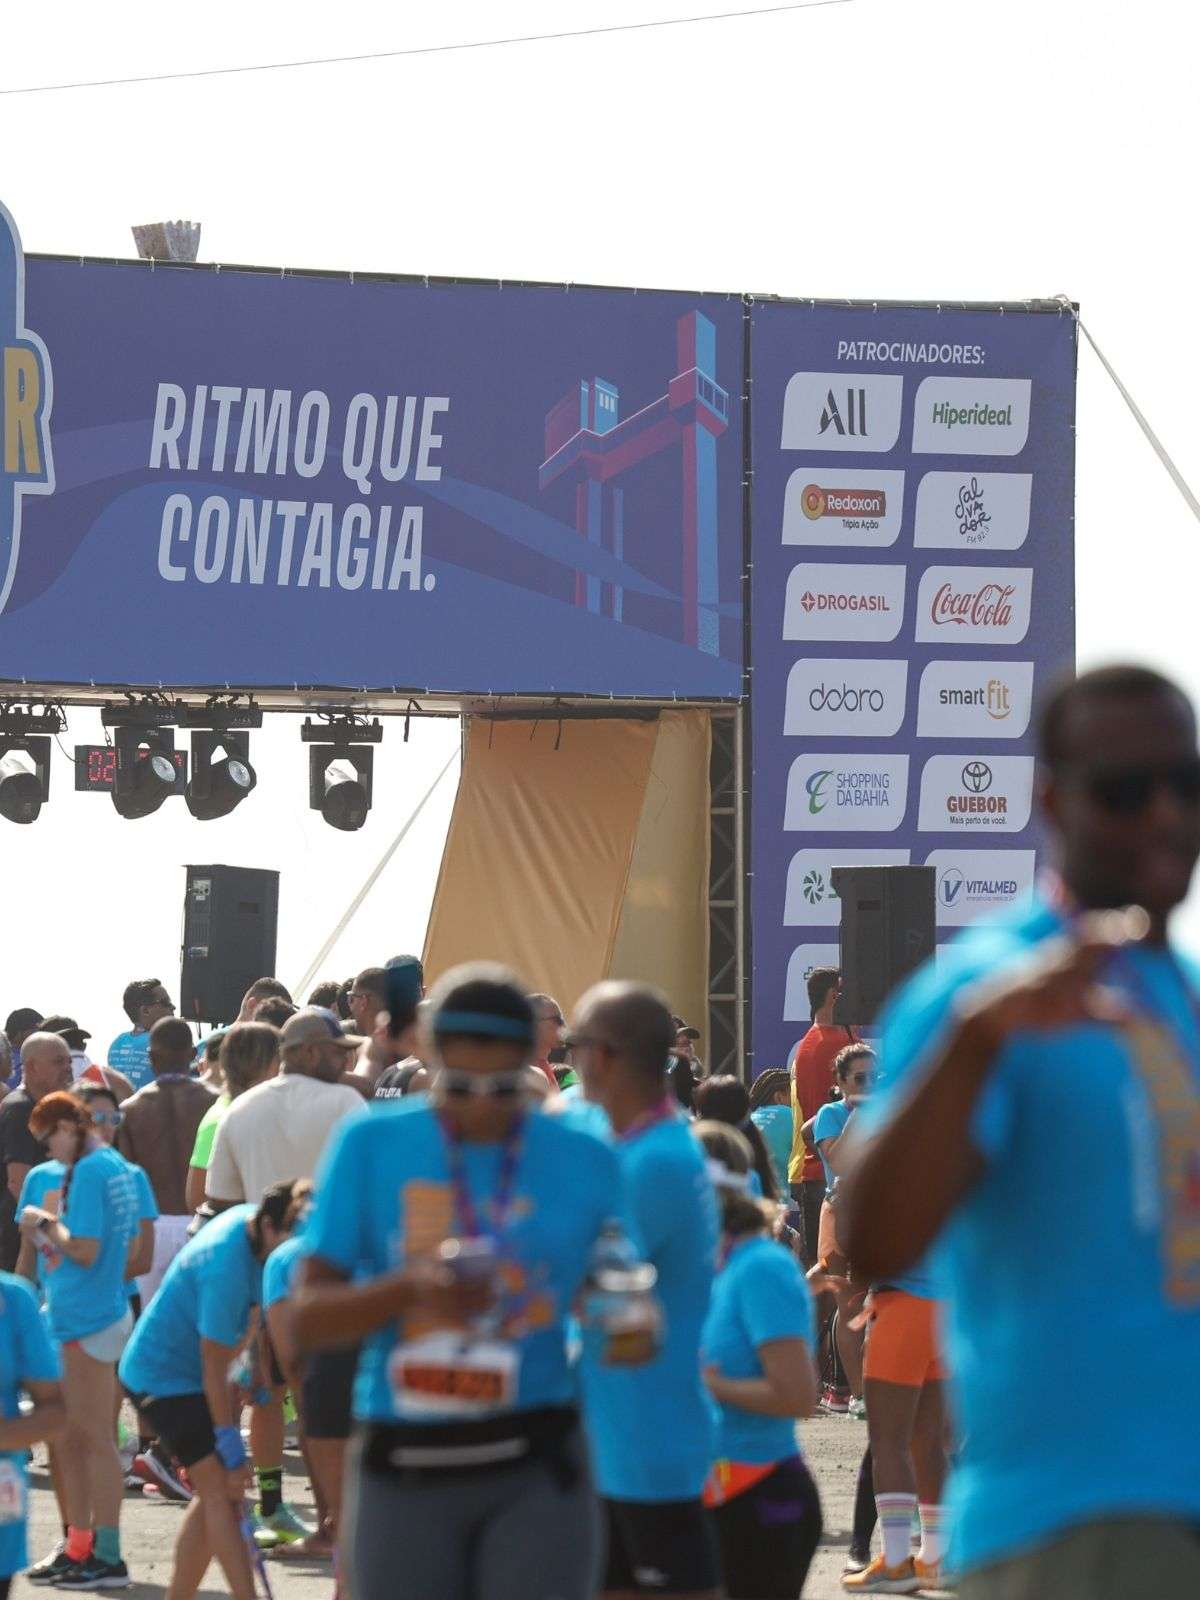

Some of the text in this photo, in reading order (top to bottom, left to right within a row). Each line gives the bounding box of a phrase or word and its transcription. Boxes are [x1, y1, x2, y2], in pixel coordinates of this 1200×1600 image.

[837, 340, 986, 364] PATROCINADORES:
[932, 402, 1012, 429] Hiperideal
[149, 383, 450, 495] RITMO QUE
[827, 495, 880, 511] Redoxon
[860, 519, 879, 530] Ação
[158, 493, 436, 592] CONTAGIA.
[817, 594, 890, 612] DROGASIL
[809, 683, 884, 712] dobro
[836, 773, 890, 788] SHOPPING
[854, 790, 889, 806] BAHIA
[946, 796, 1008, 813] GUEBOR
[966, 880, 1017, 894] VITALMED
